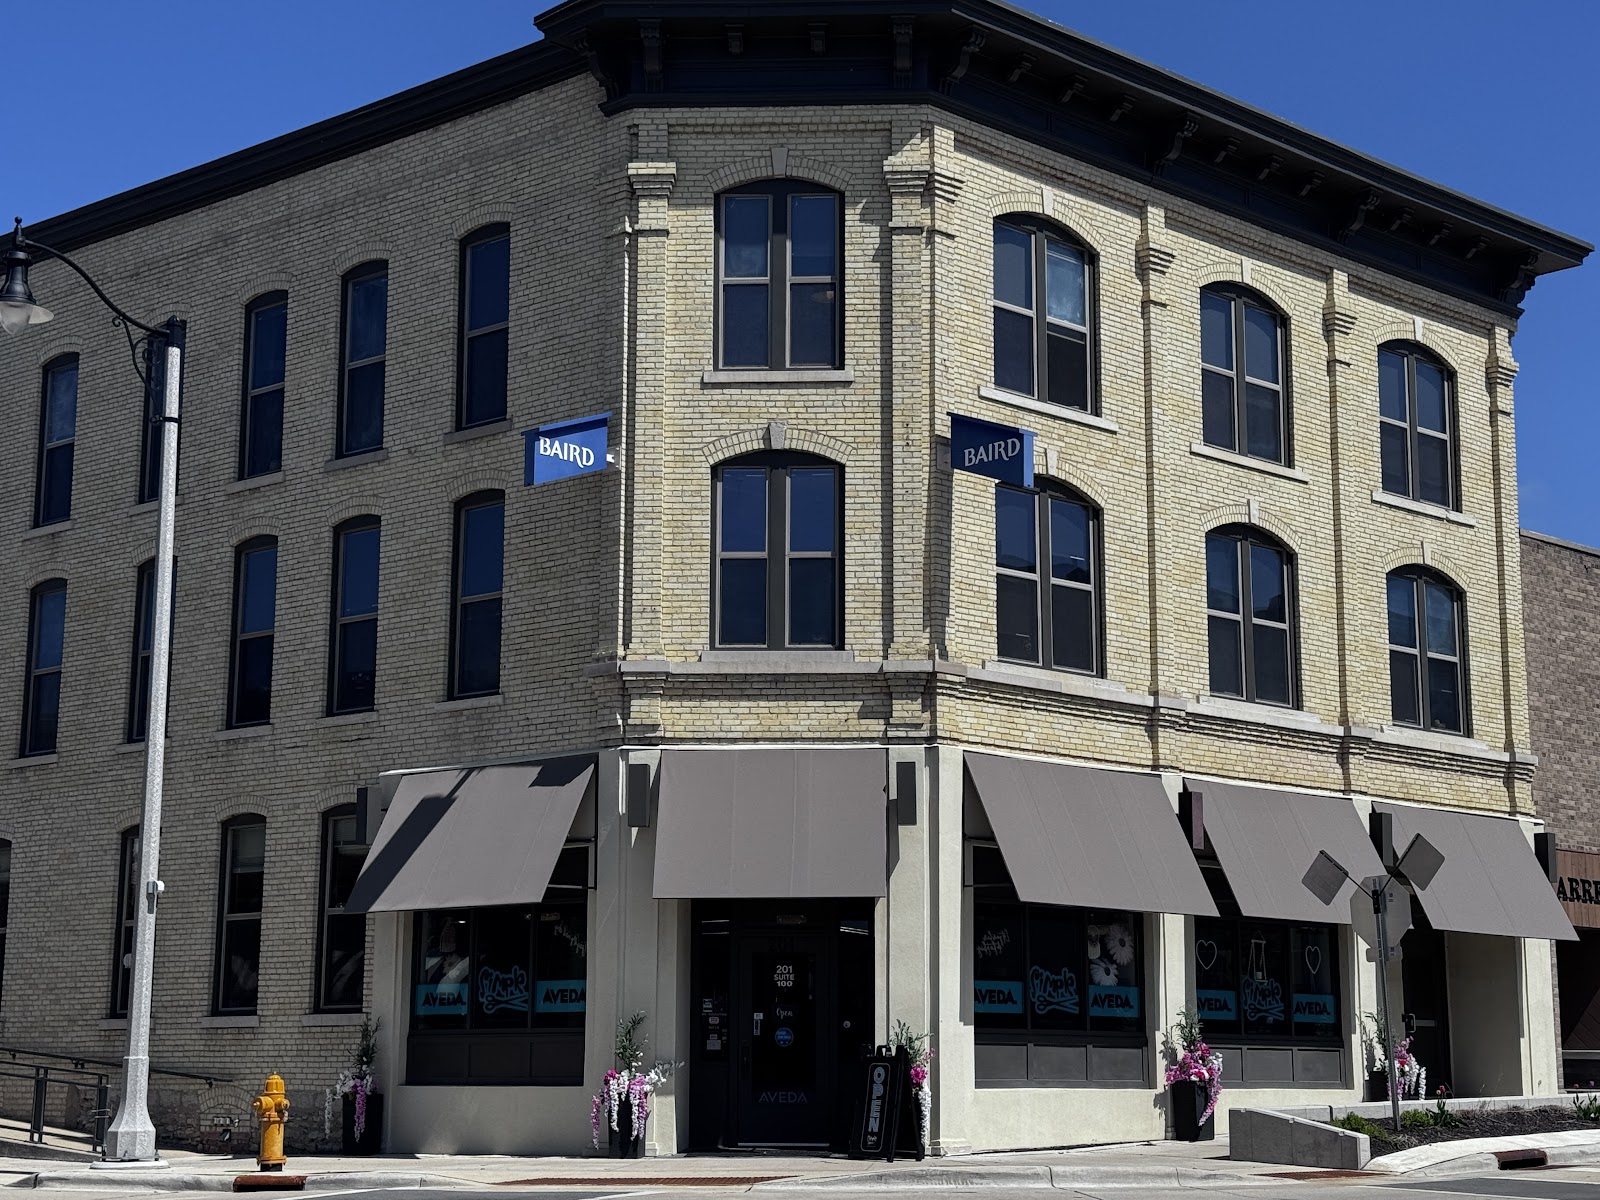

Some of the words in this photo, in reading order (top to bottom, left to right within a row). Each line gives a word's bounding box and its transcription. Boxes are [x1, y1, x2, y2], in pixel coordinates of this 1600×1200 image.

[539, 436, 595, 470] BAIRD
[963, 438, 1021, 468] BAIRD
[775, 965, 793, 974] 201
[776, 1007, 794, 1020] Open
[758, 1092, 808, 1103] AVEDA
[867, 1066, 886, 1133] OPEN
